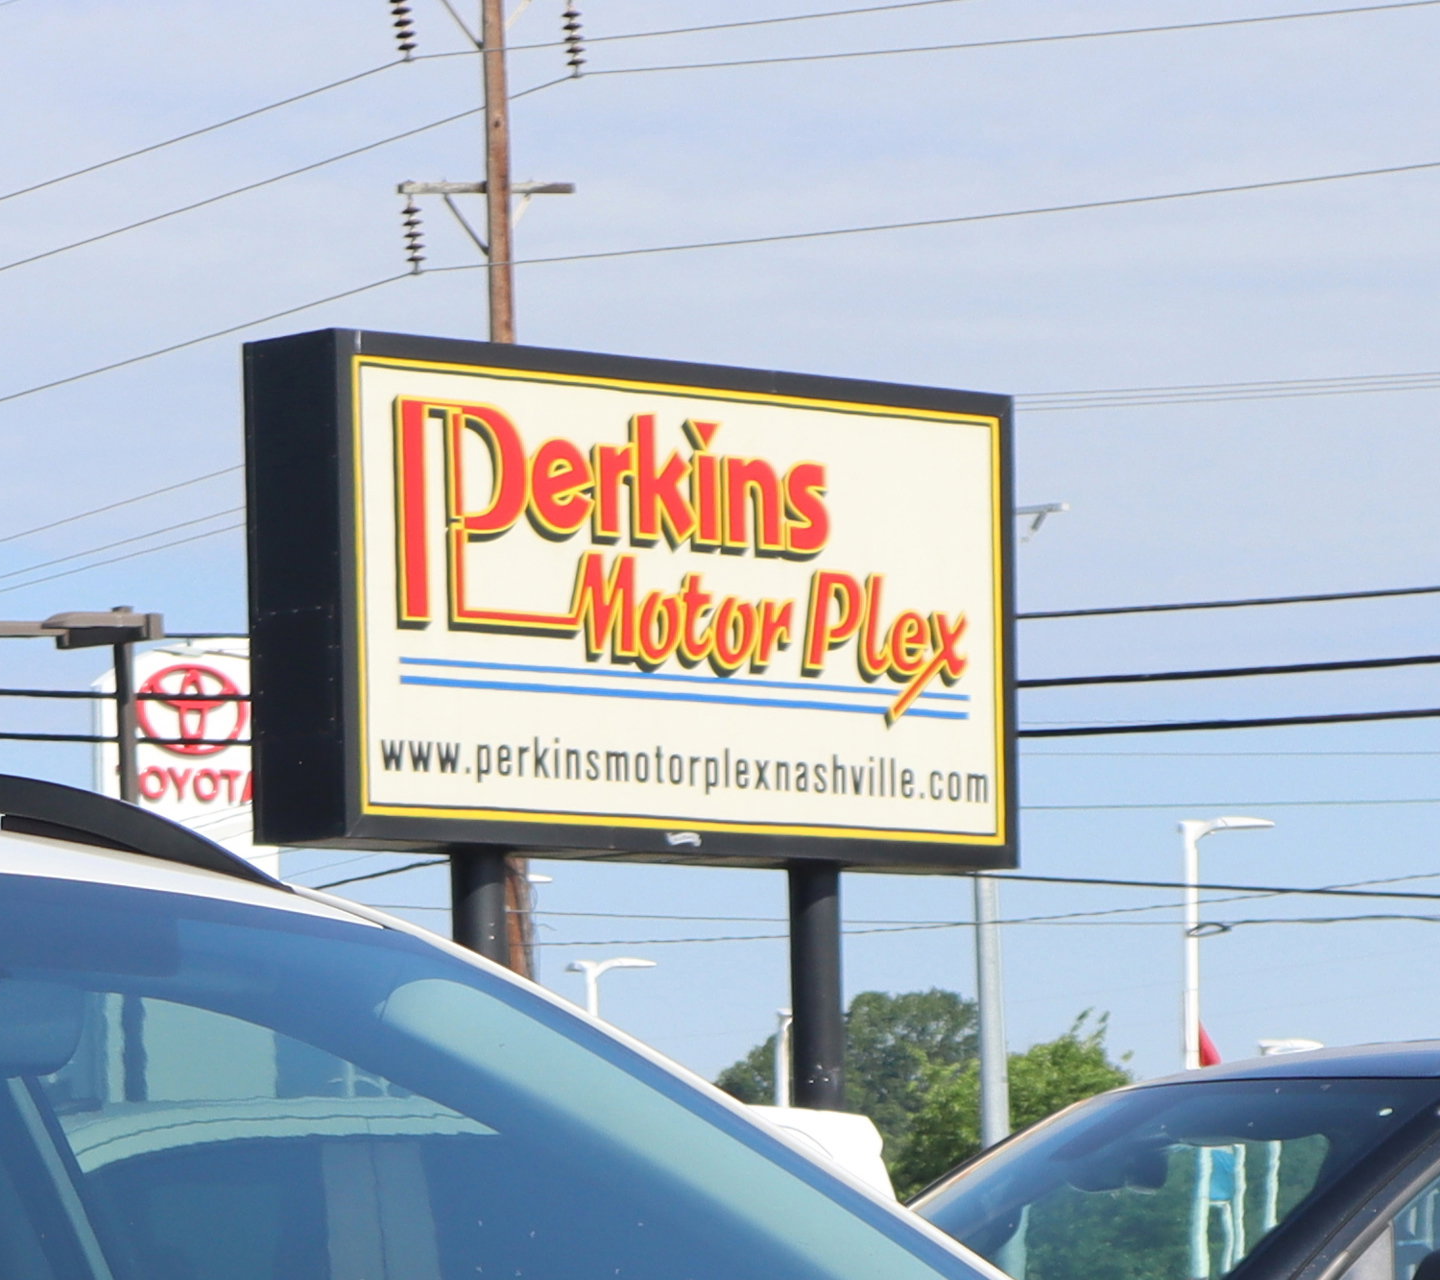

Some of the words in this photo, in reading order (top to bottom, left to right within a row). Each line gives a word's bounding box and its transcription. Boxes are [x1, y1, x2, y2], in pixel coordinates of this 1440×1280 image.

[396, 395, 830, 626] Perkins
[572, 552, 792, 673] Motor
[804, 570, 968, 725] Plex
[138, 766, 254, 803] OYOT
[381, 736, 990, 806] www.perkinsmotorplexnashville.com
